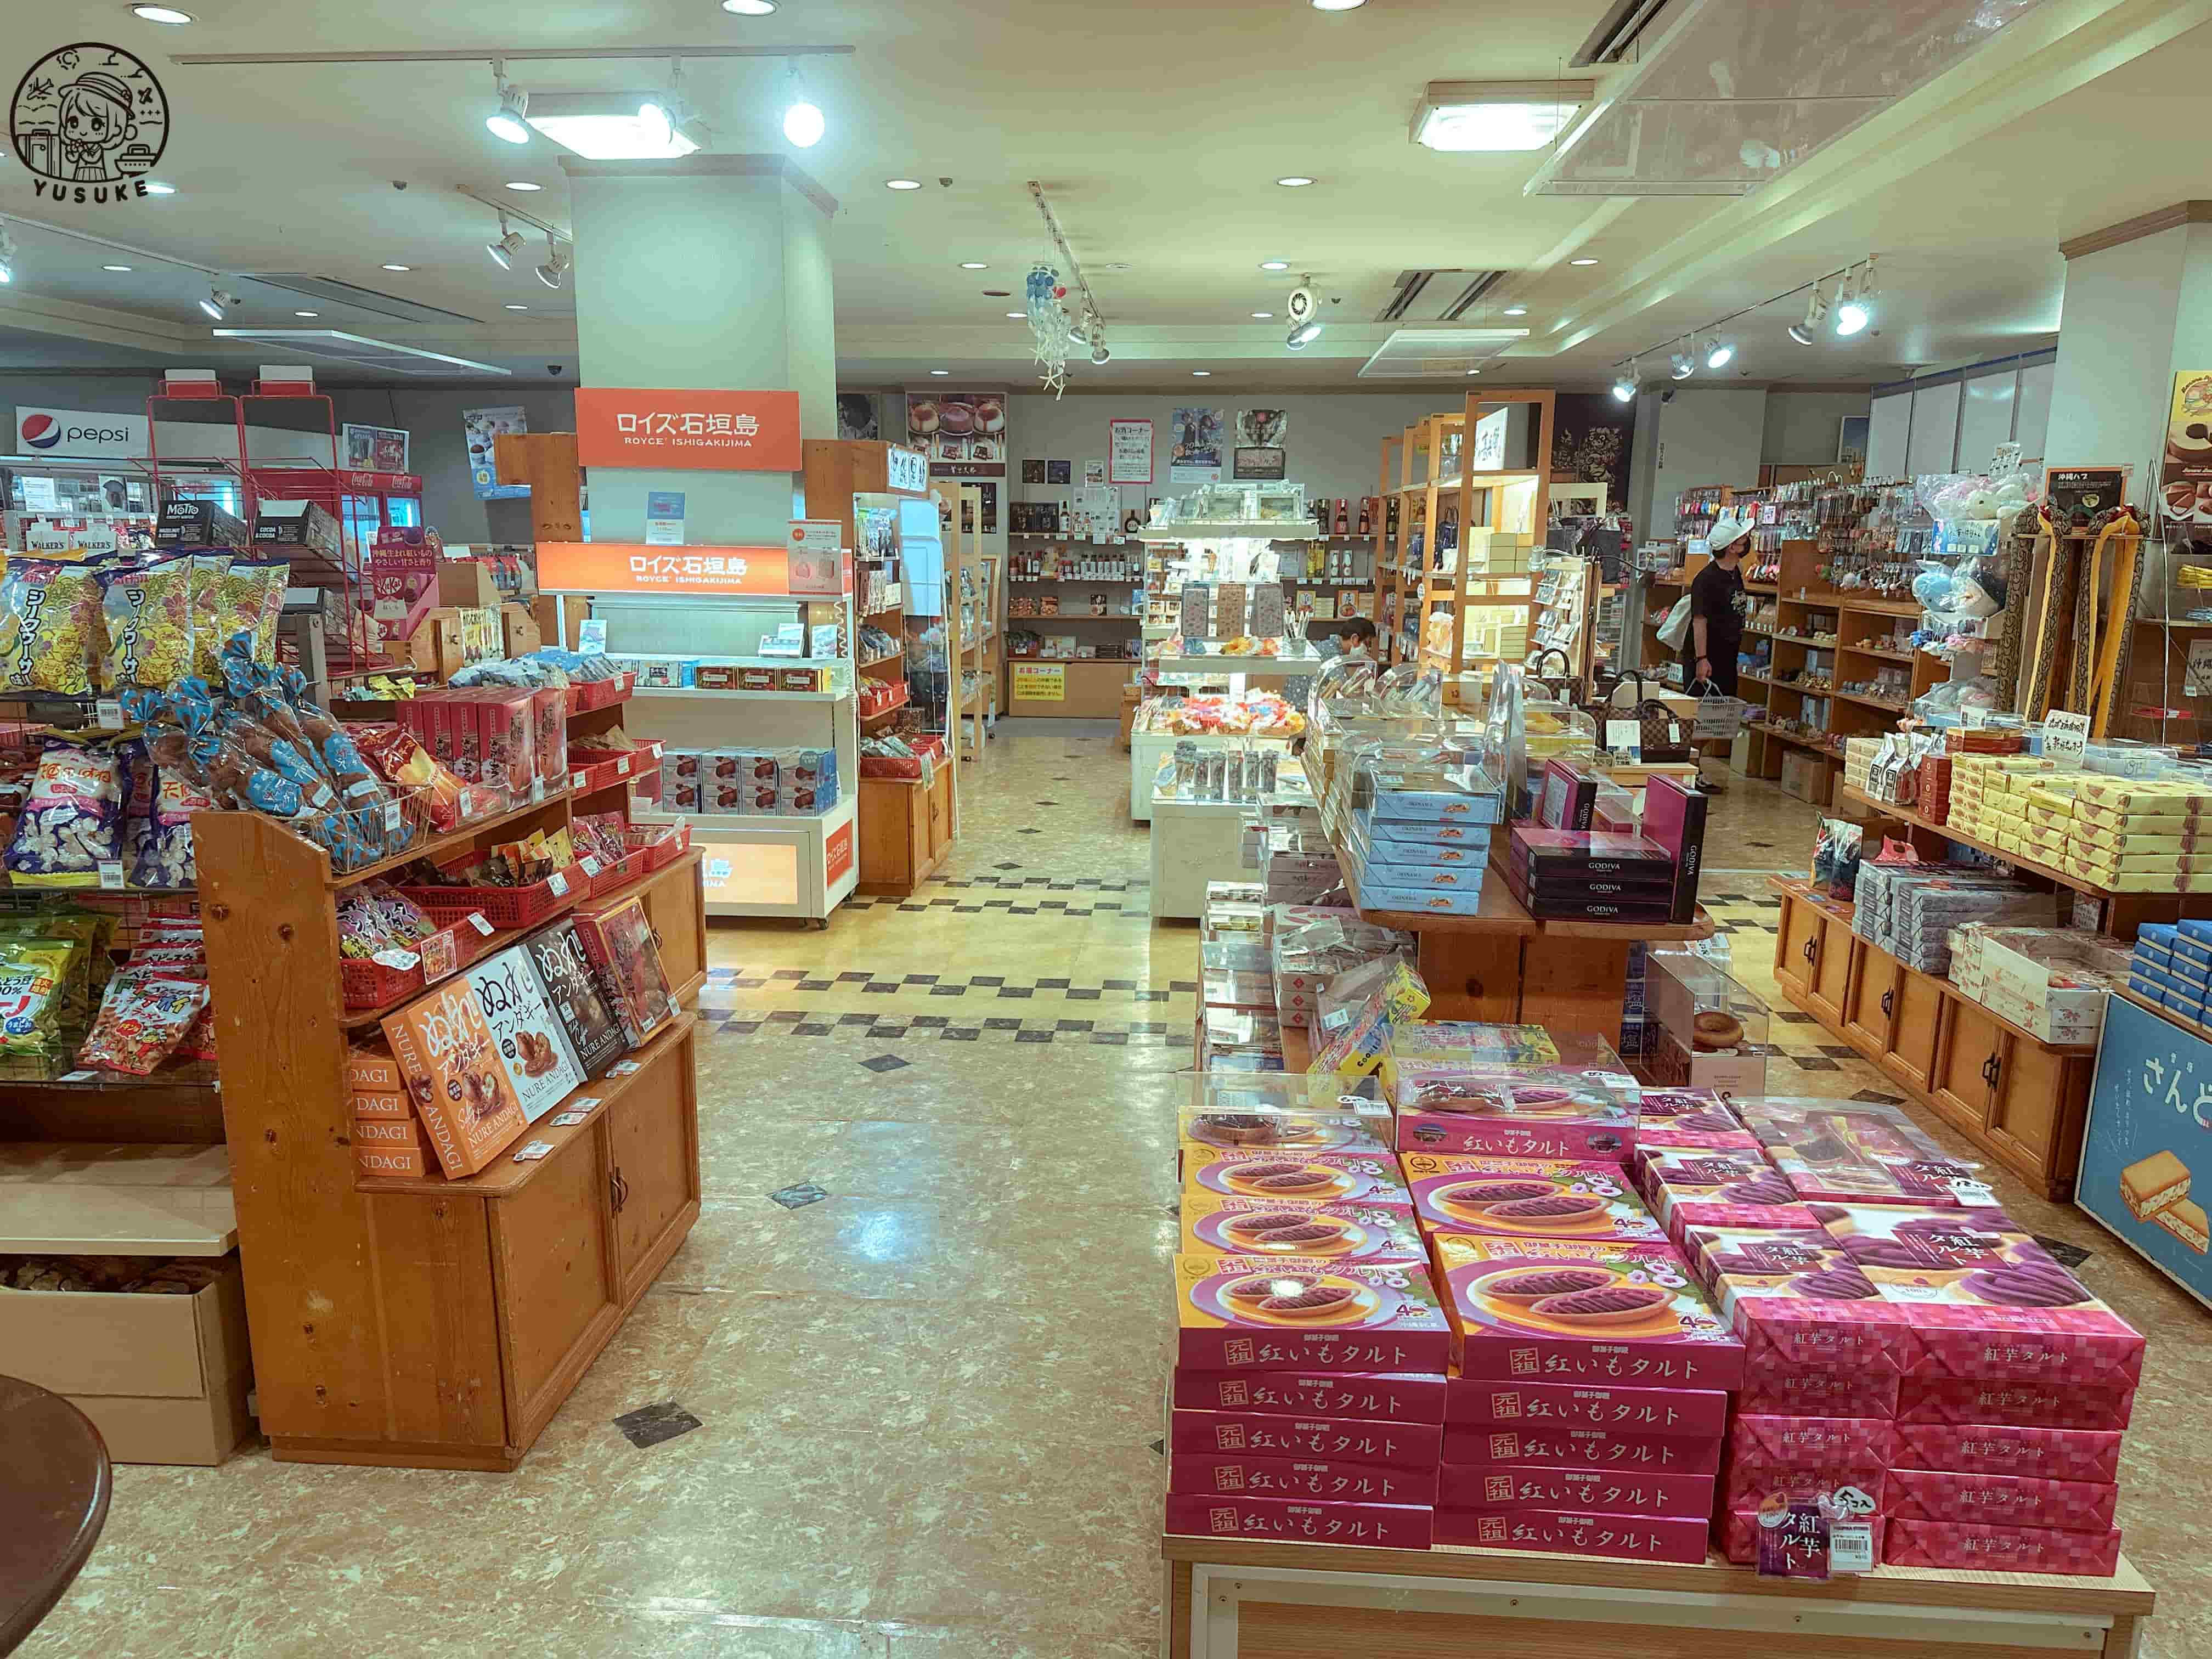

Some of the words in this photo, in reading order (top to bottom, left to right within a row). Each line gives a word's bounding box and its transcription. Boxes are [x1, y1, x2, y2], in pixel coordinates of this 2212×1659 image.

[67, 426, 129, 443] pepsi
[617, 412, 760, 437] ロイズ石垣島
[672, 438, 752, 448] ISHIGAKIJIMA
[31, 540, 64, 549] WALKER'S
[78, 540, 110, 549] WALKER'S
[630, 555, 748, 575] ロイズ石垣島
[675, 577, 742, 585] ISHIGAKIJIMA
[535, 929, 586, 983] ぬれ
[475, 962, 534, 1018] ぬれ
[552, 967, 594, 1005] アンダギー
[492, 1000, 543, 1042] アンダギー
[579, 1039, 601, 1059] NURE
[599, 1023, 621, 1047] ANDAGI
[522, 1080, 546, 1102] NURE
[545, 1061, 571, 1086] ANDAGI
[391, 1023, 422, 1075] NURE
[425, 1105, 464, 1171] ANDAGI
[468, 1125, 496, 1147] NURE
[492, 1102, 519, 1132] ANDAGI
[1463, 1136, 1571, 1156] 紅いもタルト
[1933, 1165, 1963, 1180] 紅
[1793, 1331, 1865, 1346] 紅芋タルト
[1227, 1340, 1253, 1364] 元祖
[1259, 1343, 1407, 1365] 紅いもタルト
[1513, 1350, 1538, 1373] 元祖
[1984, 1347, 2068, 1363] 紅芋タルト
[1544, 1353, 1699, 1380] 紅いもタルト
[1220, 1382, 1248, 1404] 元祖
[1785, 1377, 1853, 1391] 紅芋タルト
[1252, 1387, 1401, 1414] 紅いもタルト
[1494, 1394, 1520, 1417] 元祖
[1978, 1391, 2061, 1406] 紅芋タルト
[1526, 1398, 1679, 1426] 紅いもタルト
[1217, 1425, 1245, 1448] 元祖
[1250, 1430, 1397, 1457] 紅いもタルト
[1491, 1435, 1517, 1458] 元祖
[1782, 1430, 1852, 1444] 紅芋タルト
[1523, 1439, 1675, 1464] 紅いもタルト
[1961, 1440, 2046, 1457] 紅芋タルト
[1216, 1467, 1244, 1489] 元祖
[1248, 1471, 1395, 1497] 紅いもタルト
[1486, 1477, 1513, 1500] 元祖
[1519, 1482, 1669, 1508] 紅いもタルト
[1959, 1489, 2042, 1506] 紅芋タルト
[1211, 1509, 1238, 1531] 元祖
[1243, 1514, 1388, 1540] 紅いもタルト
[1480, 1518, 1506, 1541] 元祖
[1512, 1523, 1662, 1552] 紅いもタルト
[1779, 1511, 1801, 1571] タルト
[1798, 1512, 1822, 1559] 紅芋
[1963, 1537, 2045, 1554] 紅芋タルト
